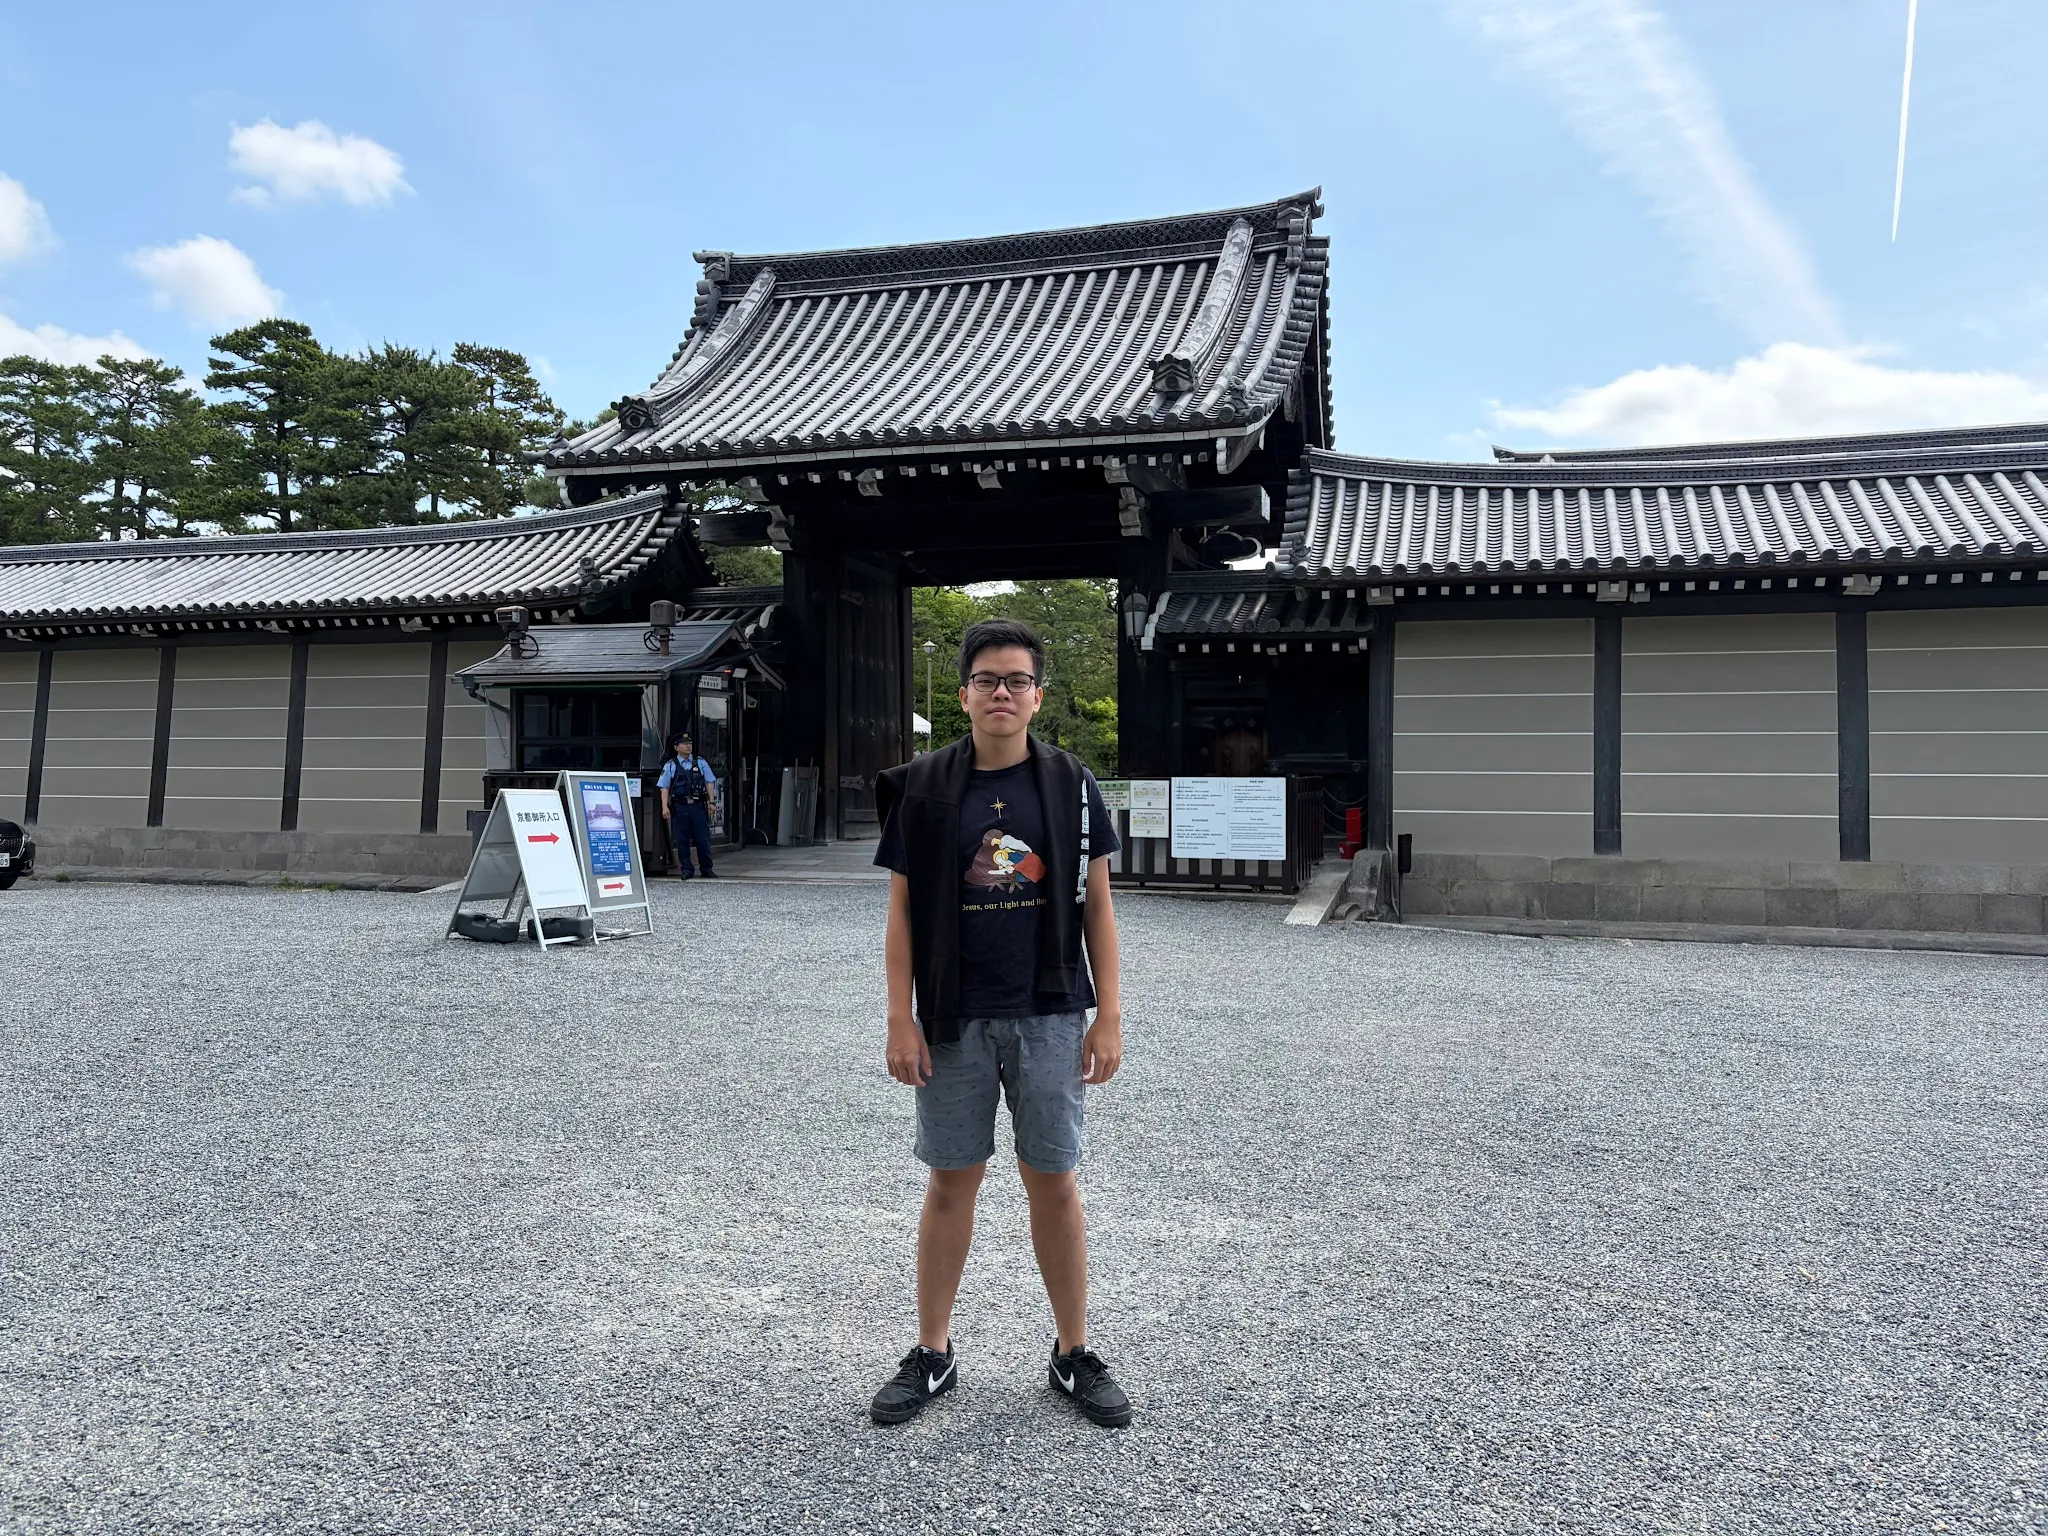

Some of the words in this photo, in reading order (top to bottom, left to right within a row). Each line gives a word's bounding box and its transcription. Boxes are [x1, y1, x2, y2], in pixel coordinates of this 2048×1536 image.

[516, 812, 560, 822] 京都御所入口
[962, 903, 983, 911] Jesus,
[1000, 900, 1020, 910] Light
[1021, 898, 1035, 907] and
[1036, 897, 1047, 906] Hop
